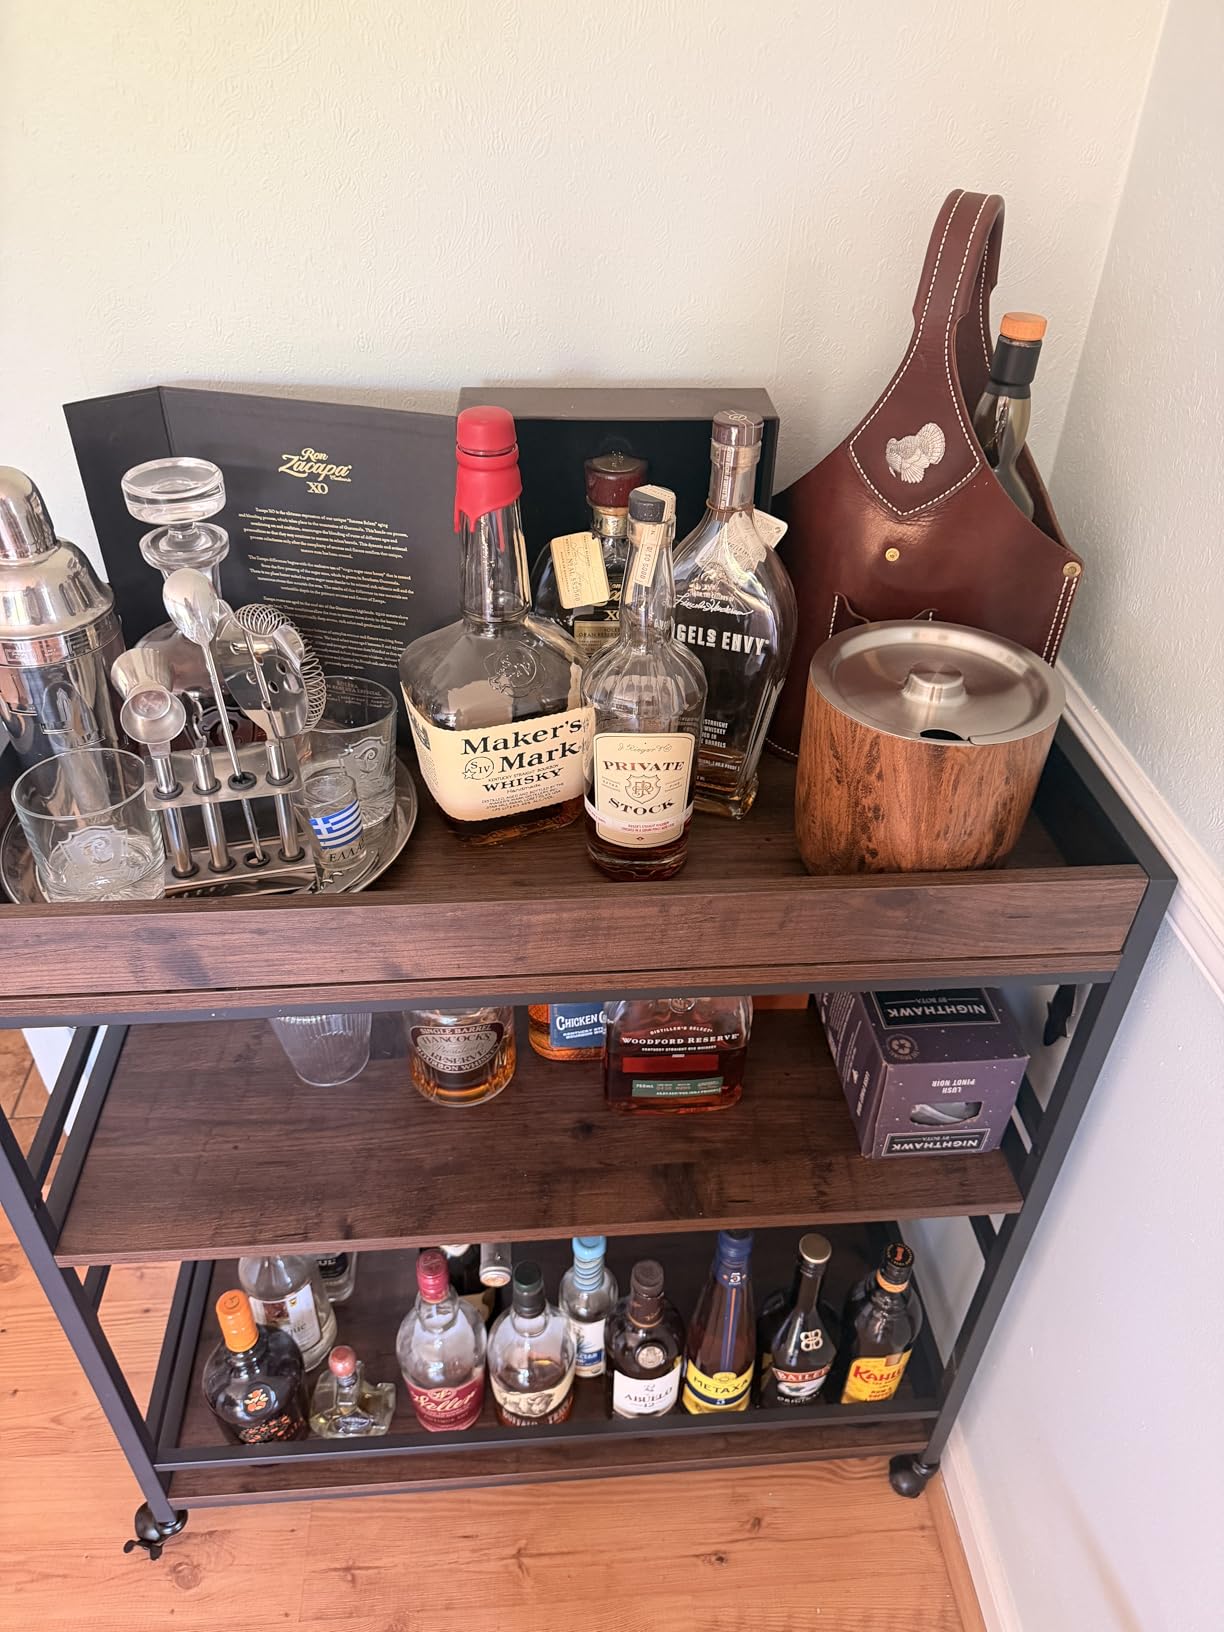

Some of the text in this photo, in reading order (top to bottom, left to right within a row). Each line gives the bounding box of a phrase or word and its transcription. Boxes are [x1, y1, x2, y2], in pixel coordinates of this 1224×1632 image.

[300, 447, 328, 463] Ron
[278, 454, 352, 482] Zacapa
[306, 481, 329, 495] XO
[721, 631, 765, 656] ENVY
[460, 719, 582, 755] Maker's
[498, 741, 579, 774] Mark
[602, 760, 685, 771] PRIVATE
[482, 766, 565, 793] WHISKY
[608, 797, 675, 816] STOCK
[888, 1004, 986, 1018] NIGHTHAWK
[420, 1024, 492, 1035] SINGLE BARREL
[556, 1015, 598, 1031] CHICKEN
[622, 1033, 738, 1045] WOODFORD RESERVE
[930, 1078, 976, 1087] PINOT NOIR
[941, 1086, 962, 1094] LUSH
[892, 1139, 979, 1151] NIGHTHAWK
[730, 1272, 741, 1283] 5
[694, 1376, 748, 1394] METAXA
[624, 1387, 674, 1403] ABUELO
